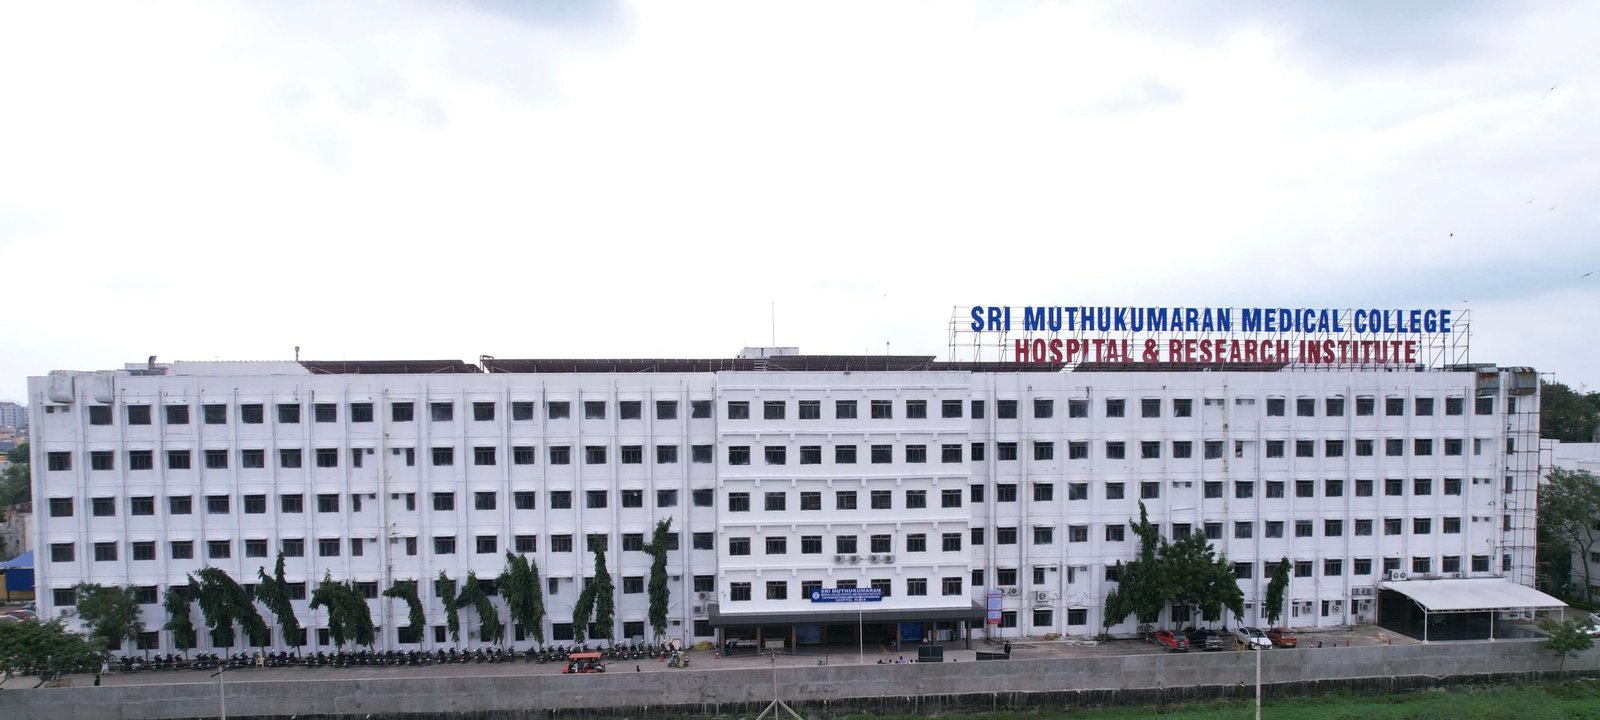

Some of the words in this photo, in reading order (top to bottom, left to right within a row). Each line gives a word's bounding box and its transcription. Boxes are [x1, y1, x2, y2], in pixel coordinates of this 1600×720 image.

[971, 306, 1010, 332] SRI
[1024, 306, 1231, 333] MUTHUKUMARAN
[1242, 308, 1344, 333] MEDICAL
[1354, 309, 1451, 333] COLLEGE
[1015, 338, 1133, 365] HOSPITAL
[1142, 338, 1160, 364] &
[1169, 339, 1289, 364] RESEARCH
[1300, 339, 1416, 364] INSTITUTE
